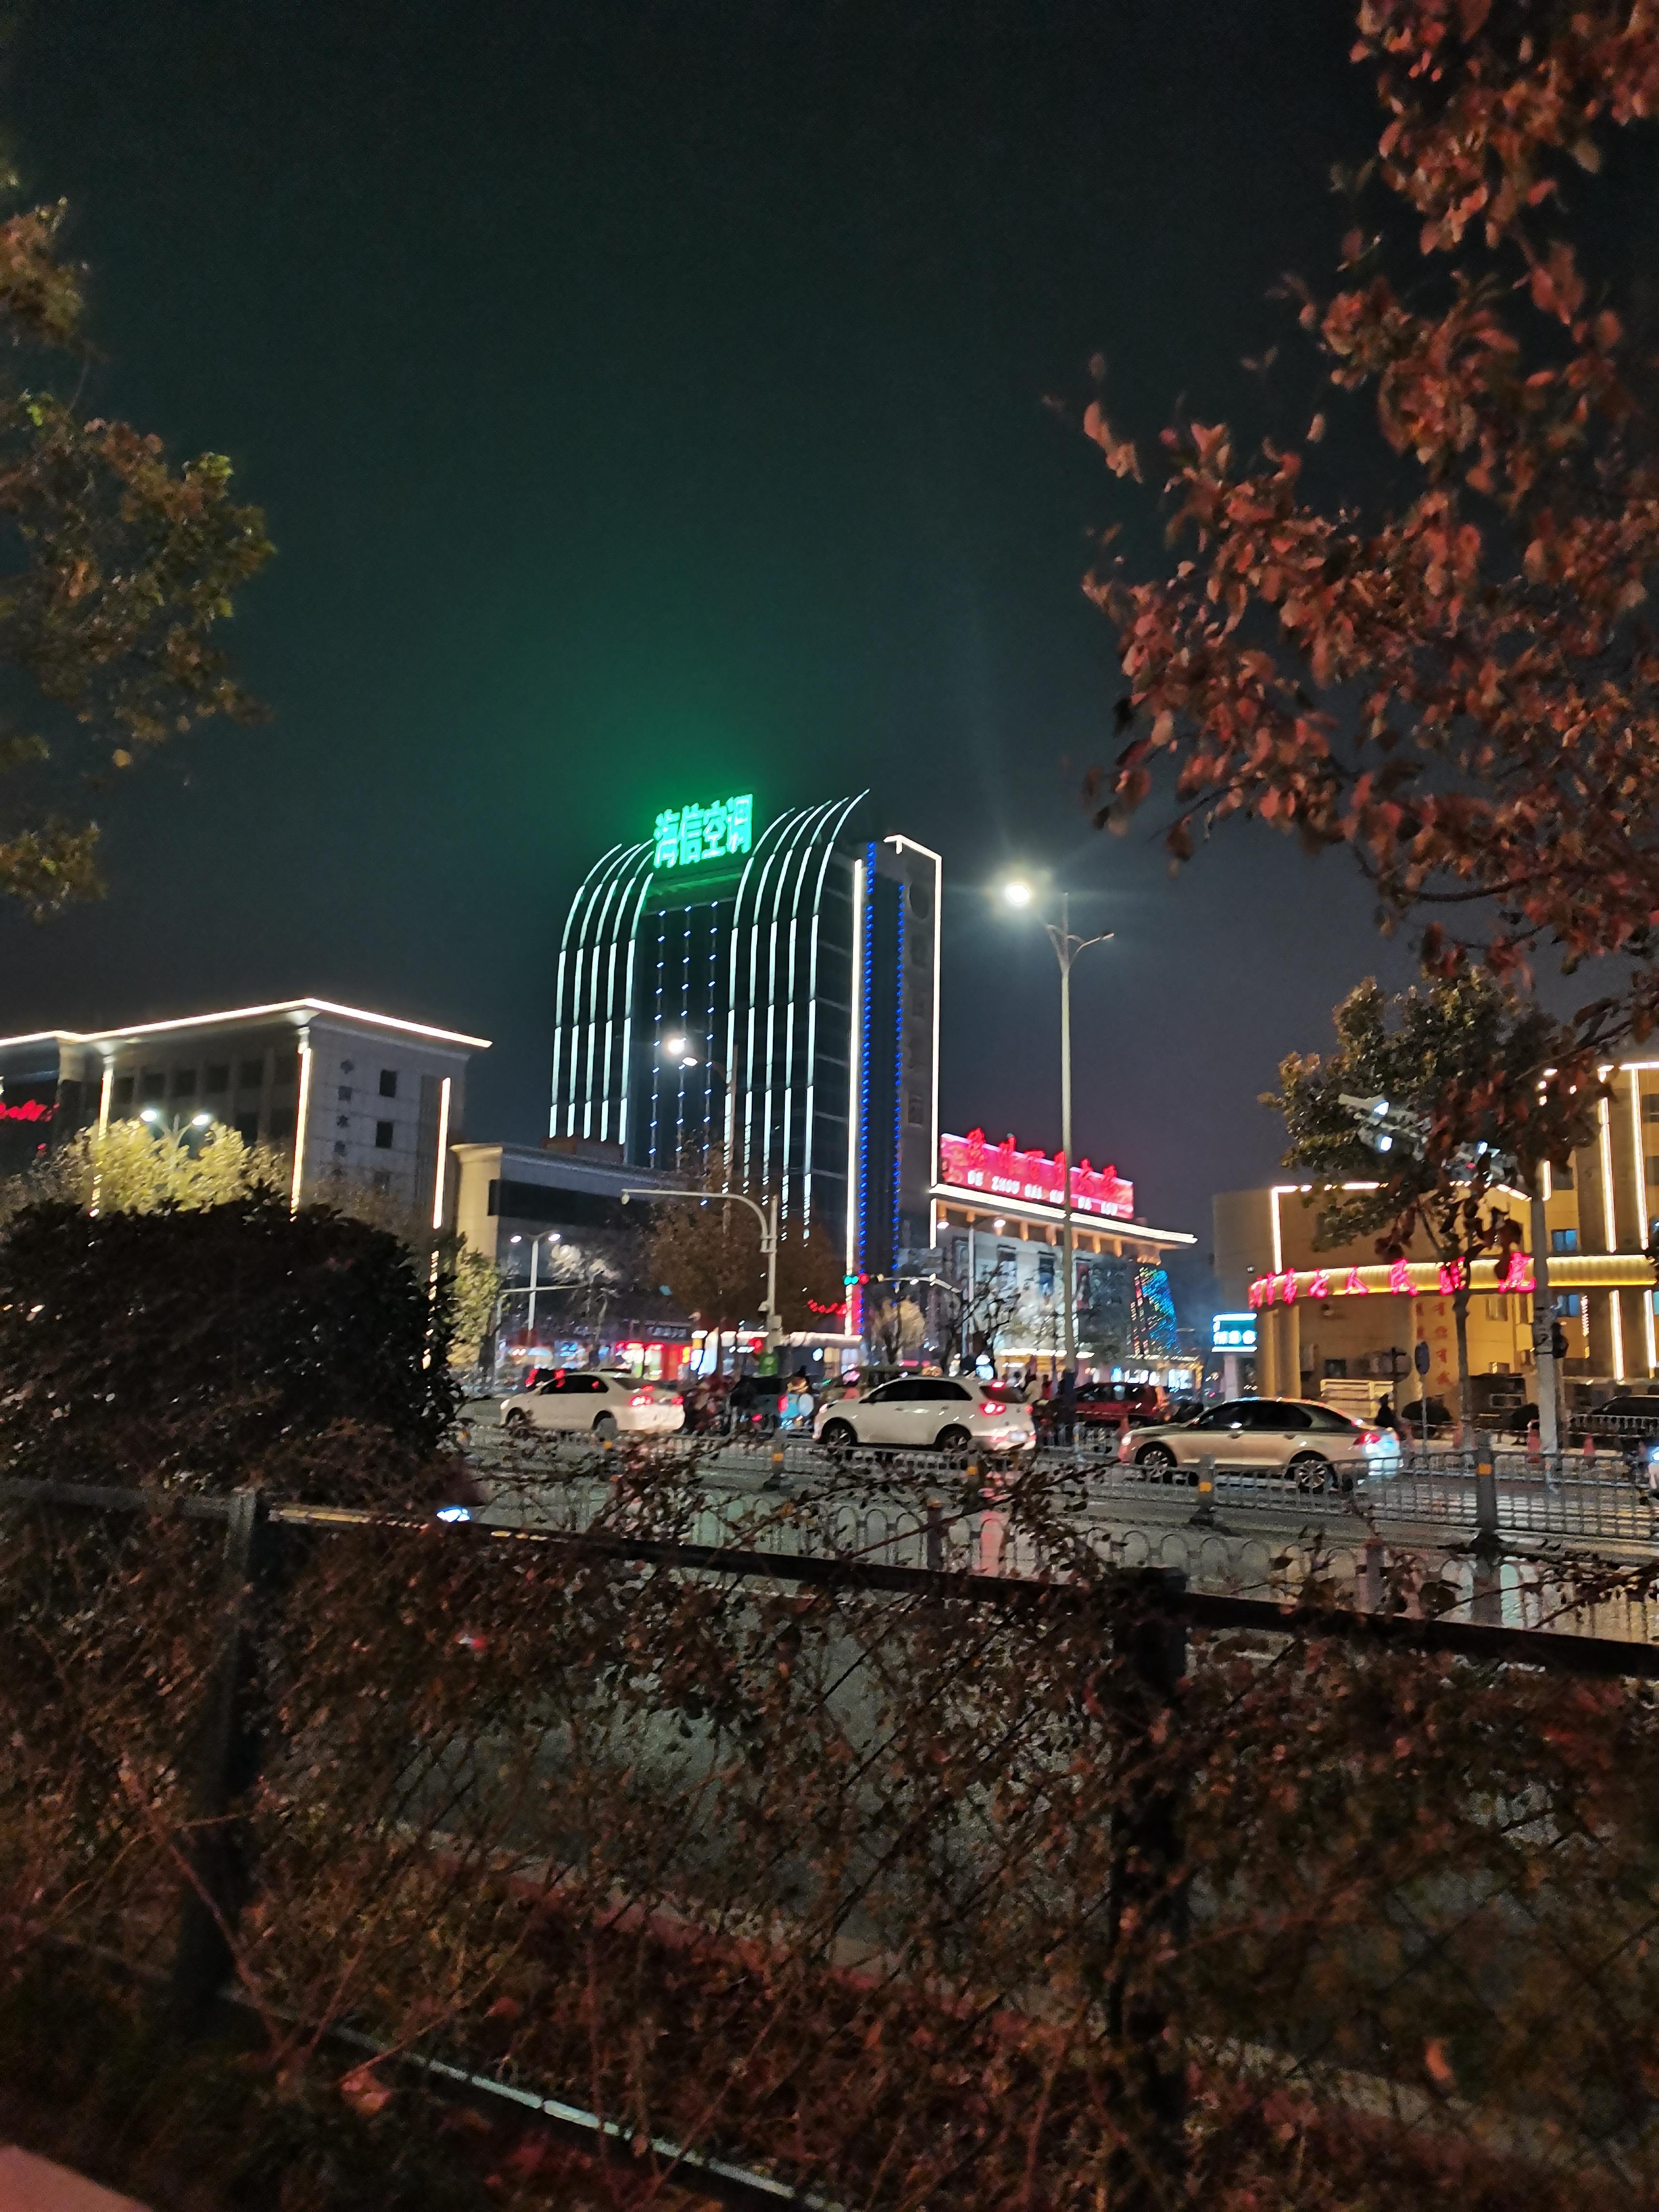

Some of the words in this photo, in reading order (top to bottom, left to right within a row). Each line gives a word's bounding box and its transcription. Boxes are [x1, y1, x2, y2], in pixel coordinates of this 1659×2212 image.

[653, 793, 753, 868] 海信空调
[1049, 1189, 1065, 1204] HU
